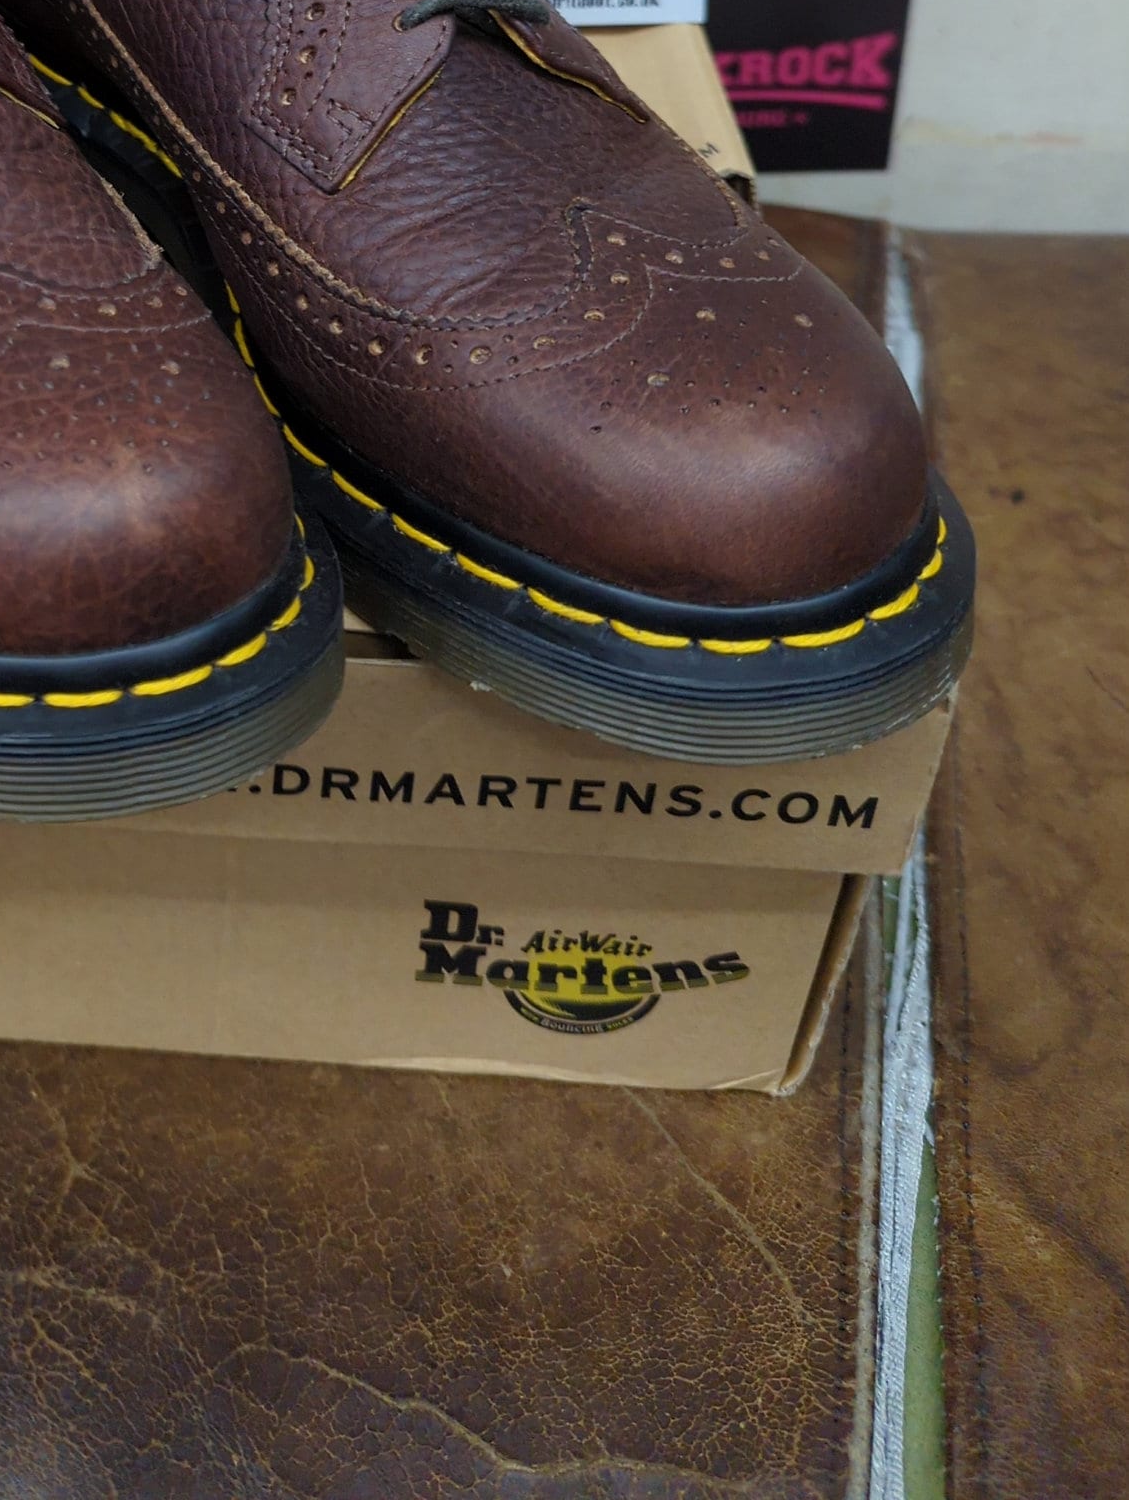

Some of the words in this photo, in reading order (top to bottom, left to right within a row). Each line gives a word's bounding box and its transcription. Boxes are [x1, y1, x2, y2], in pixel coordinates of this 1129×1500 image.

[228, 763, 878, 830] .DRMARTENS.COM
[421, 898, 505, 946] Dr.
[520, 929, 653, 957] AirWair
[415, 942, 750, 995] Martens
